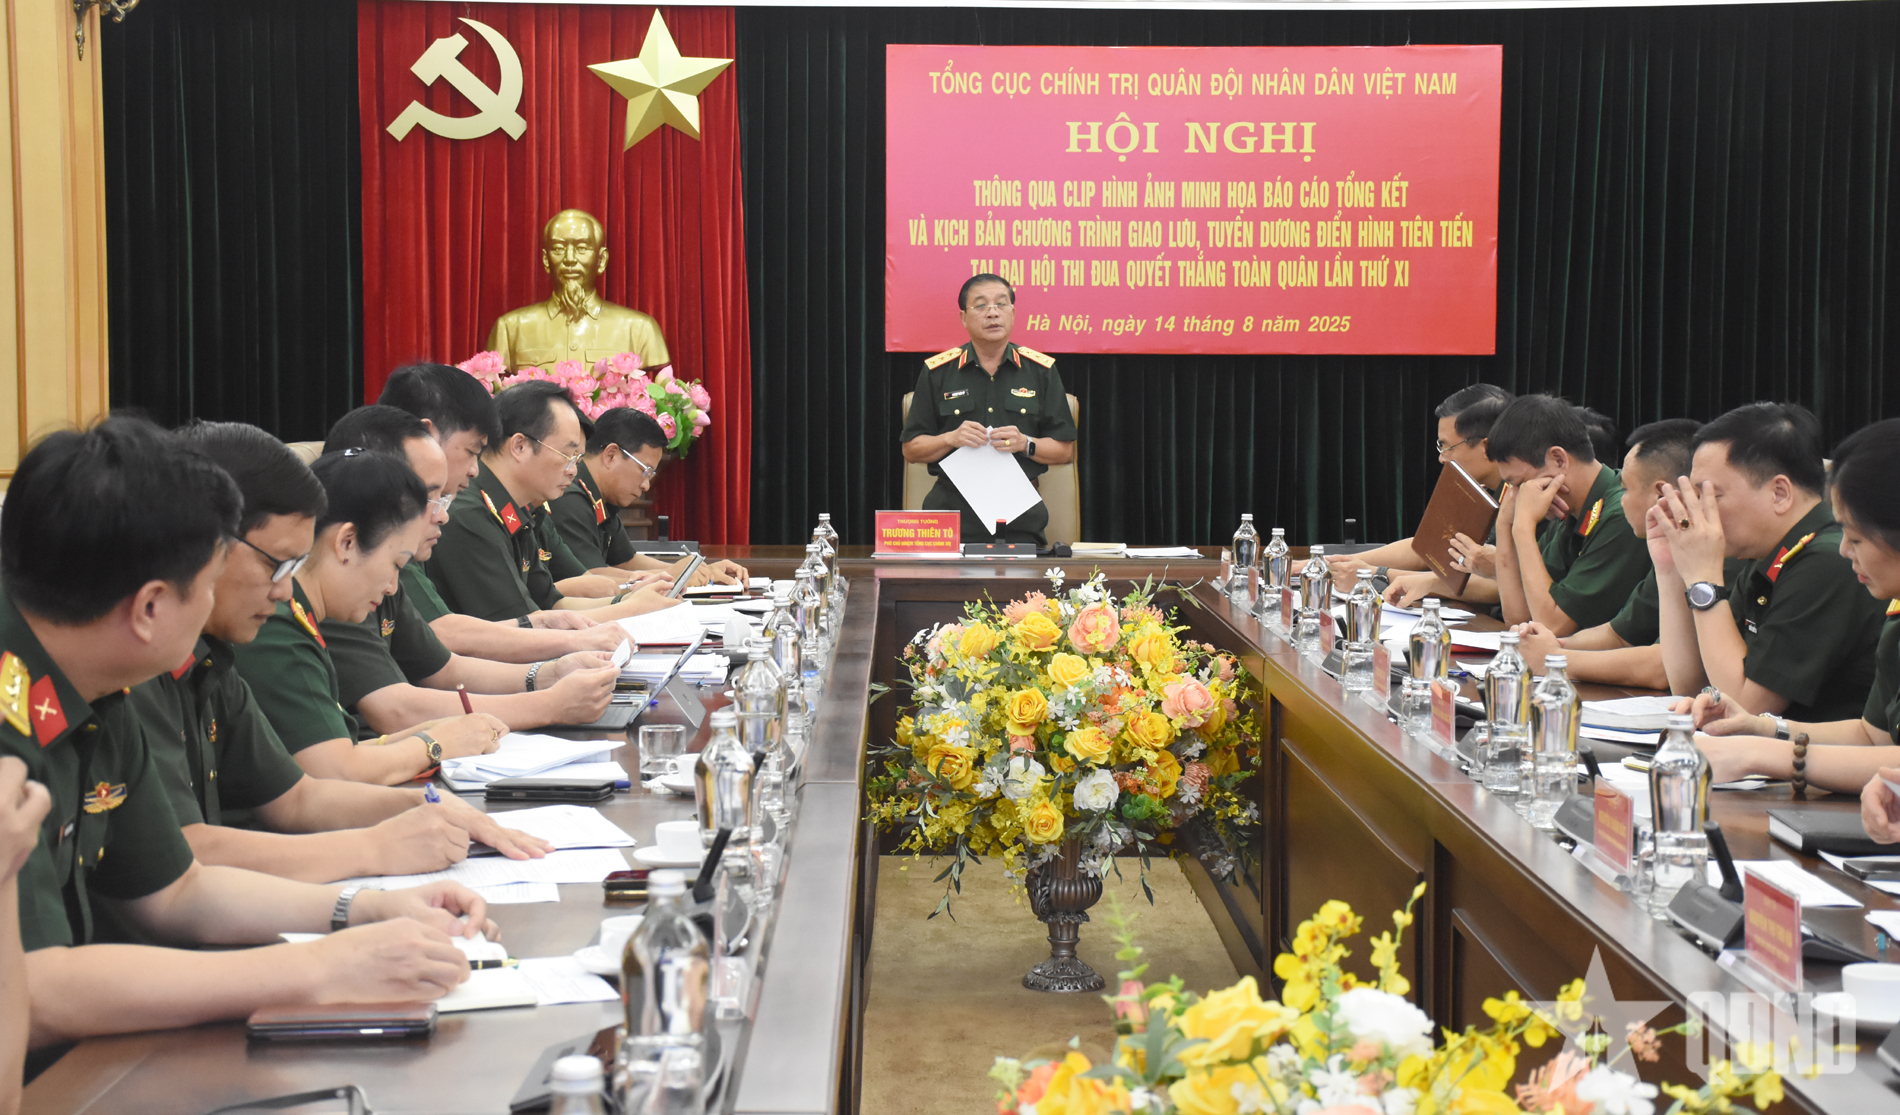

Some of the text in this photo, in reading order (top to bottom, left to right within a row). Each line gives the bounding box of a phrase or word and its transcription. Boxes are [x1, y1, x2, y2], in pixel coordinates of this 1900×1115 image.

[929, 60, 1458, 101] TỔNG CỤC CHÍNH TRỊ QUÂN ĐỘI NHÂN DÂN VIỆT NAM
[1065, 112, 1317, 162] HỘI NGHỊ
[973, 170, 1410, 214] THÔNG QUA CLIP HÌNH ẢNH MINH HỌA BÁO CÁO TỔNG KẾT
[908, 210, 1474, 251] VÀ KỊCH BẢN CHƯƠNG TRÌNH GIAO LƯU, TUYÊN DƯƠNG ĐIỂN HÌNH TIÊN TIẾN
[1000, 259, 1025, 292] ĐẠI
[1031, 254, 1056, 292] HỘI
[1061, 260, 1085, 287] THI
[1090, 260, 1121, 287] ĐUA
[1126, 253, 1173, 289] QUYẾT
[1177, 251, 1227, 288] THẮNG
[1232, 255, 1272, 288] TOÀN
[1277, 255, 1319, 290] QUÂN
[1324, 251, 1354, 288] LẦN
[1359, 255, 1389, 288] THỨ
[1394, 260, 1410, 288] XI
[1026, 314, 1352, 336] Hà Nội, ngày 14 tháng 8 năm 2025
[882, 526, 953, 538] TRƯƠNG THIÊN TÔ
